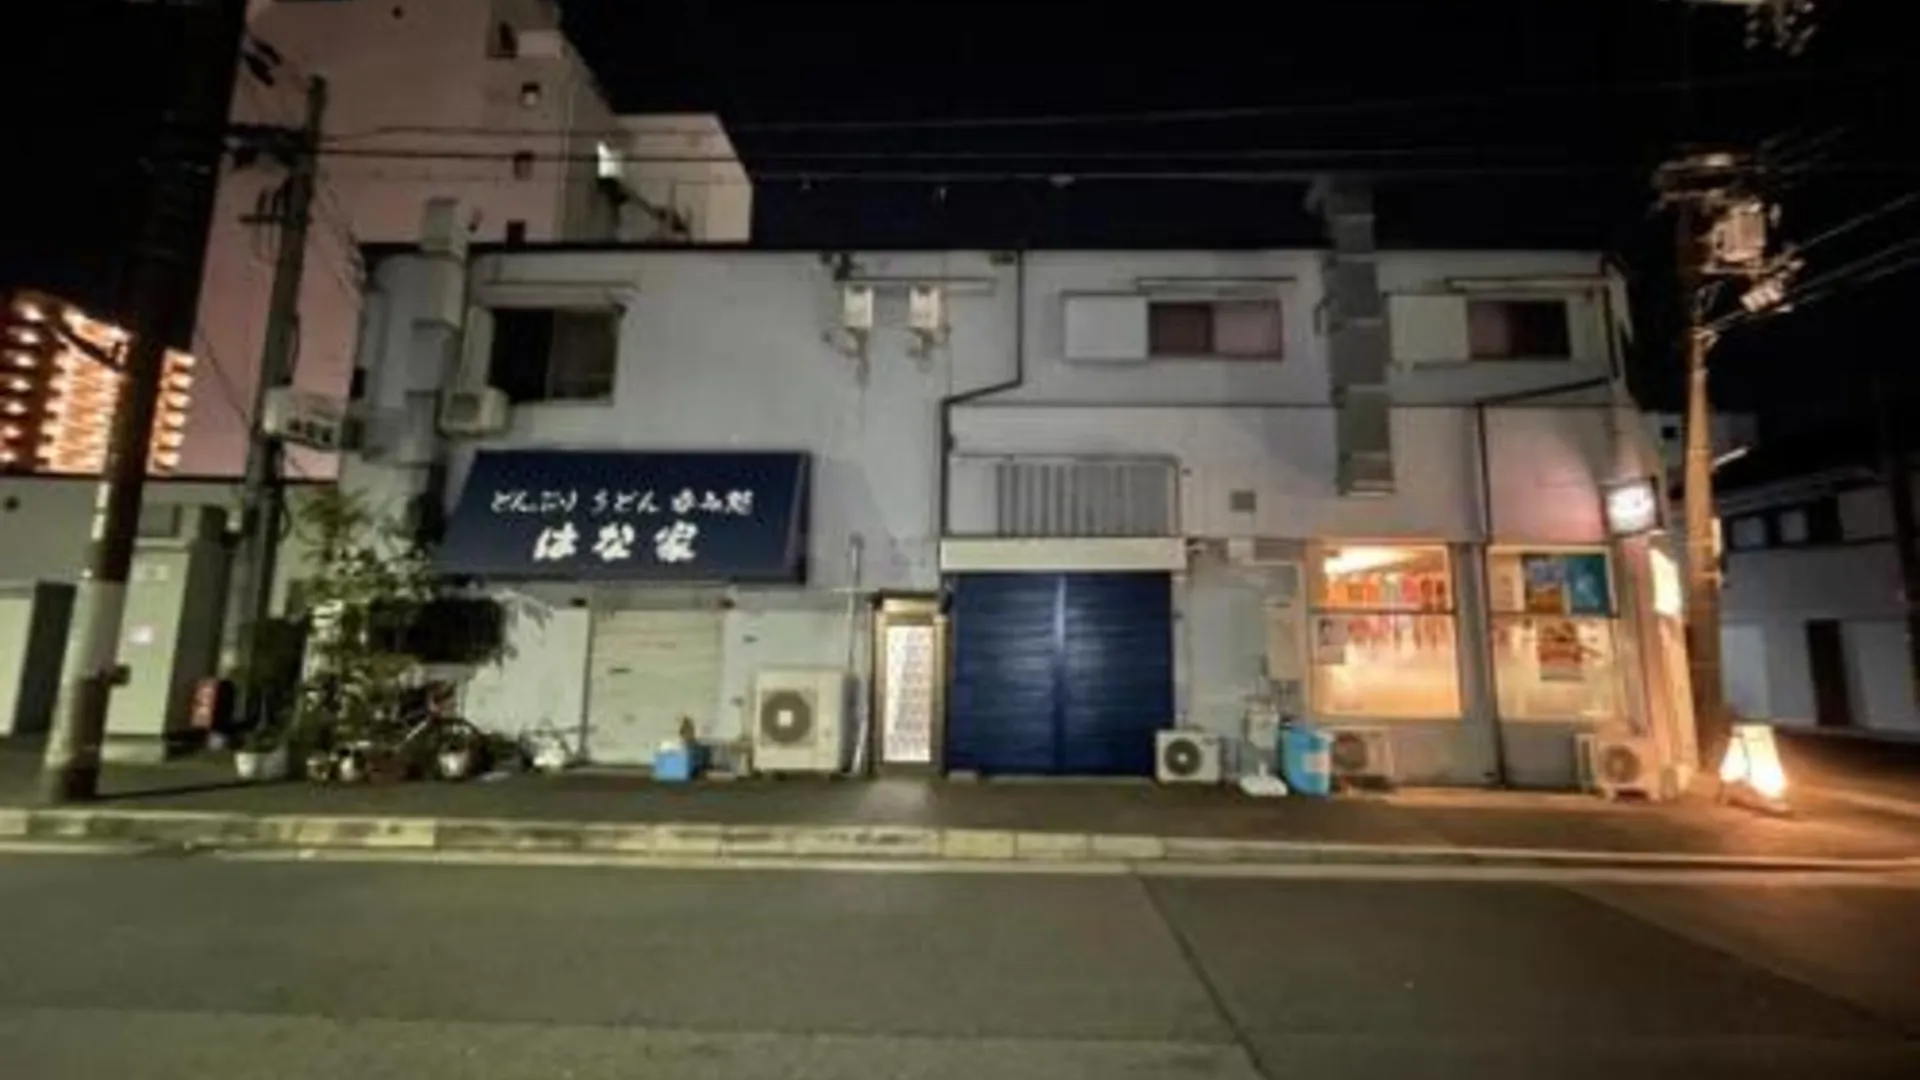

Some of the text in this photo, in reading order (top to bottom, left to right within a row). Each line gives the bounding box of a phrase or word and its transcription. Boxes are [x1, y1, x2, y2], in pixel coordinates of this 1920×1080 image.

[490, 489, 578, 513] どんぶり
[591, 489, 660, 515] うどん
